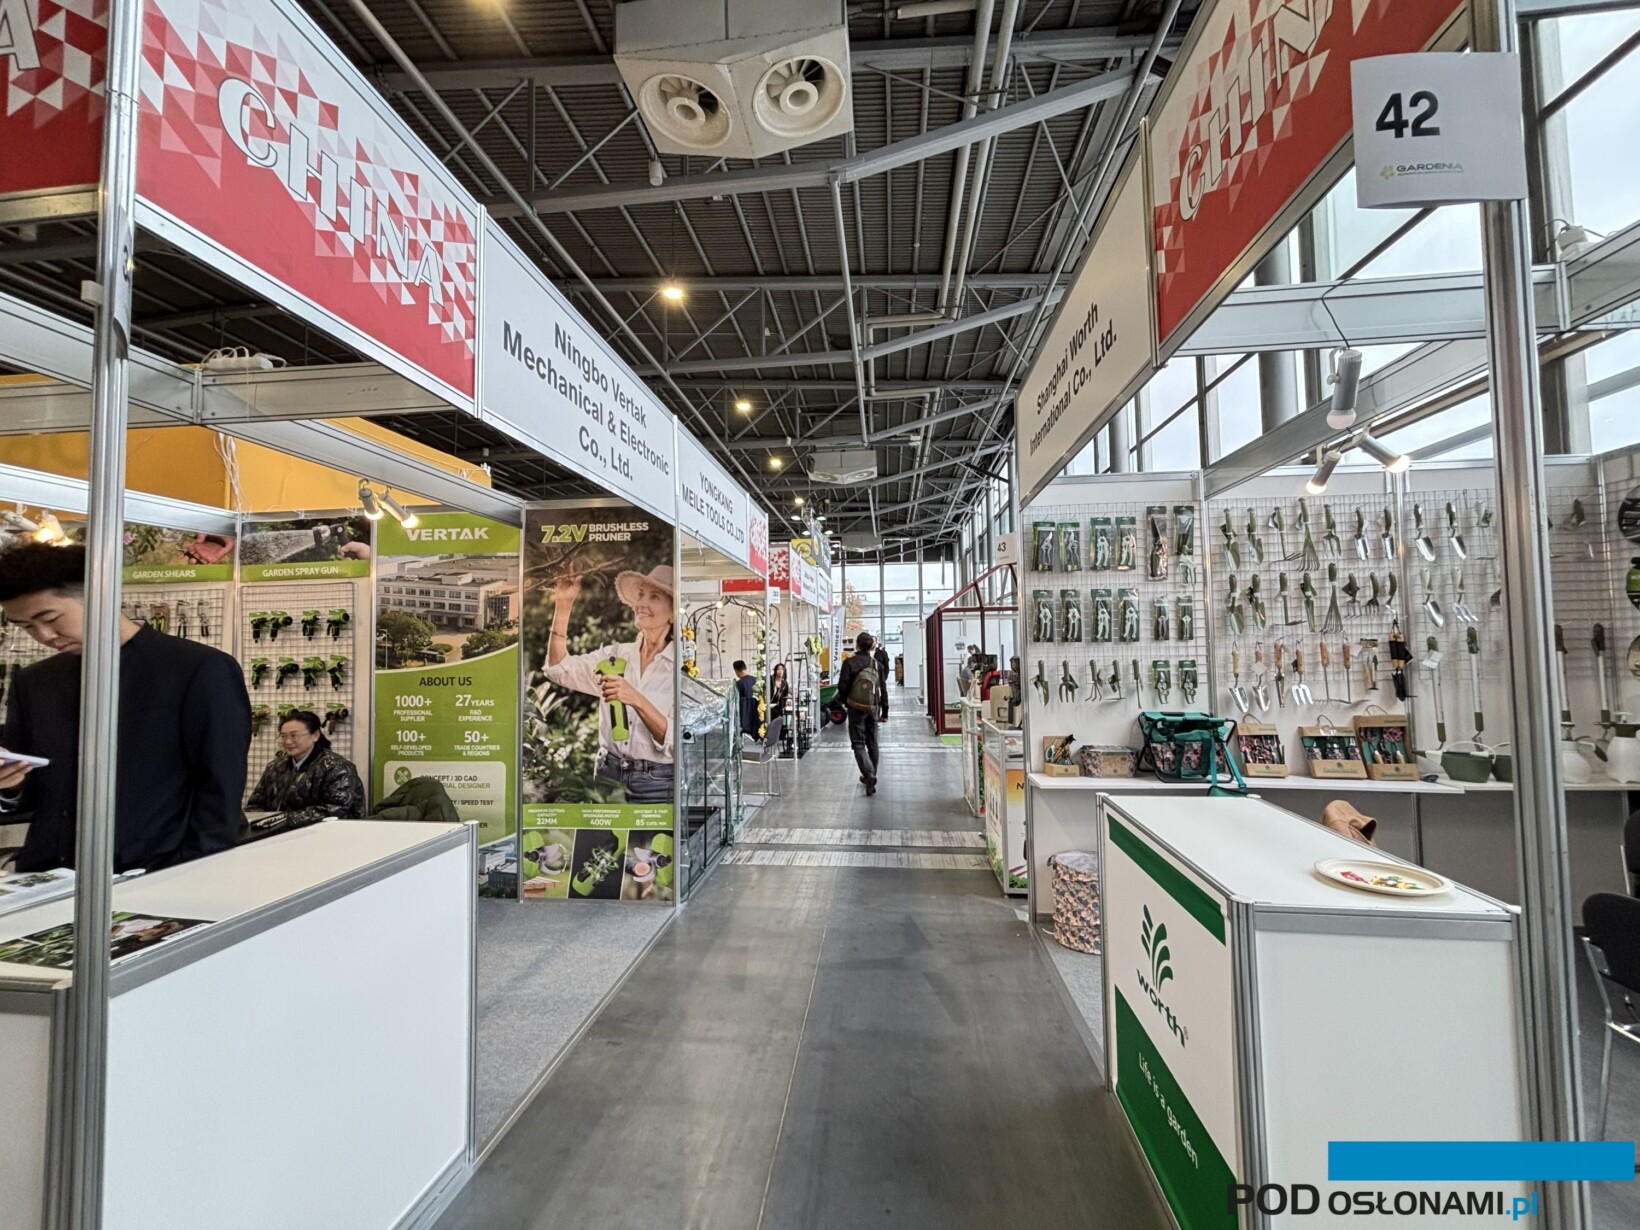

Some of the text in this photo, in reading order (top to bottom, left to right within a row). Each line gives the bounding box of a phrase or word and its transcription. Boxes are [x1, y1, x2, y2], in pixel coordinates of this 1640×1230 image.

[1375, 90, 1441, 139] 42
[1396, 162, 1463, 172] GARDENIA
[218, 77, 444, 307] CHINA
[1036, 302, 1099, 415] Shanghai Worth
[554, 322, 647, 429] Ningbo Vertak
[1029, 318, 1117, 457] International Co., Ltd.
[503, 320, 670, 476] Mechanical & Electronic
[579, 425, 633, 481] Co., Ltd.
[699, 472, 733, 515] YONGKANG
[682, 483, 705, 516] MEILE
[706, 501, 725, 531] TOOLS
[406, 527, 489, 541] VERTAK
[541, 523, 588, 544] 7.2V
[588, 521, 649, 533] BRUSHLESS
[588, 532, 632, 543] PRUNER
[997, 541, 1006, 552] 43
[132, 569, 196, 579] GARDEN SHEARS
[262, 566, 339, 577] GARDEN SPRAY GUN
[419, 676, 472, 687] ABOUT US
[394, 695, 432, 707] 1000+
[396, 730, 426, 742] 100+
[464, 731, 489, 743] 50+
[590, 818, 612, 826] 400W
[1138, 1051, 1199, 1170] Life is a garden
